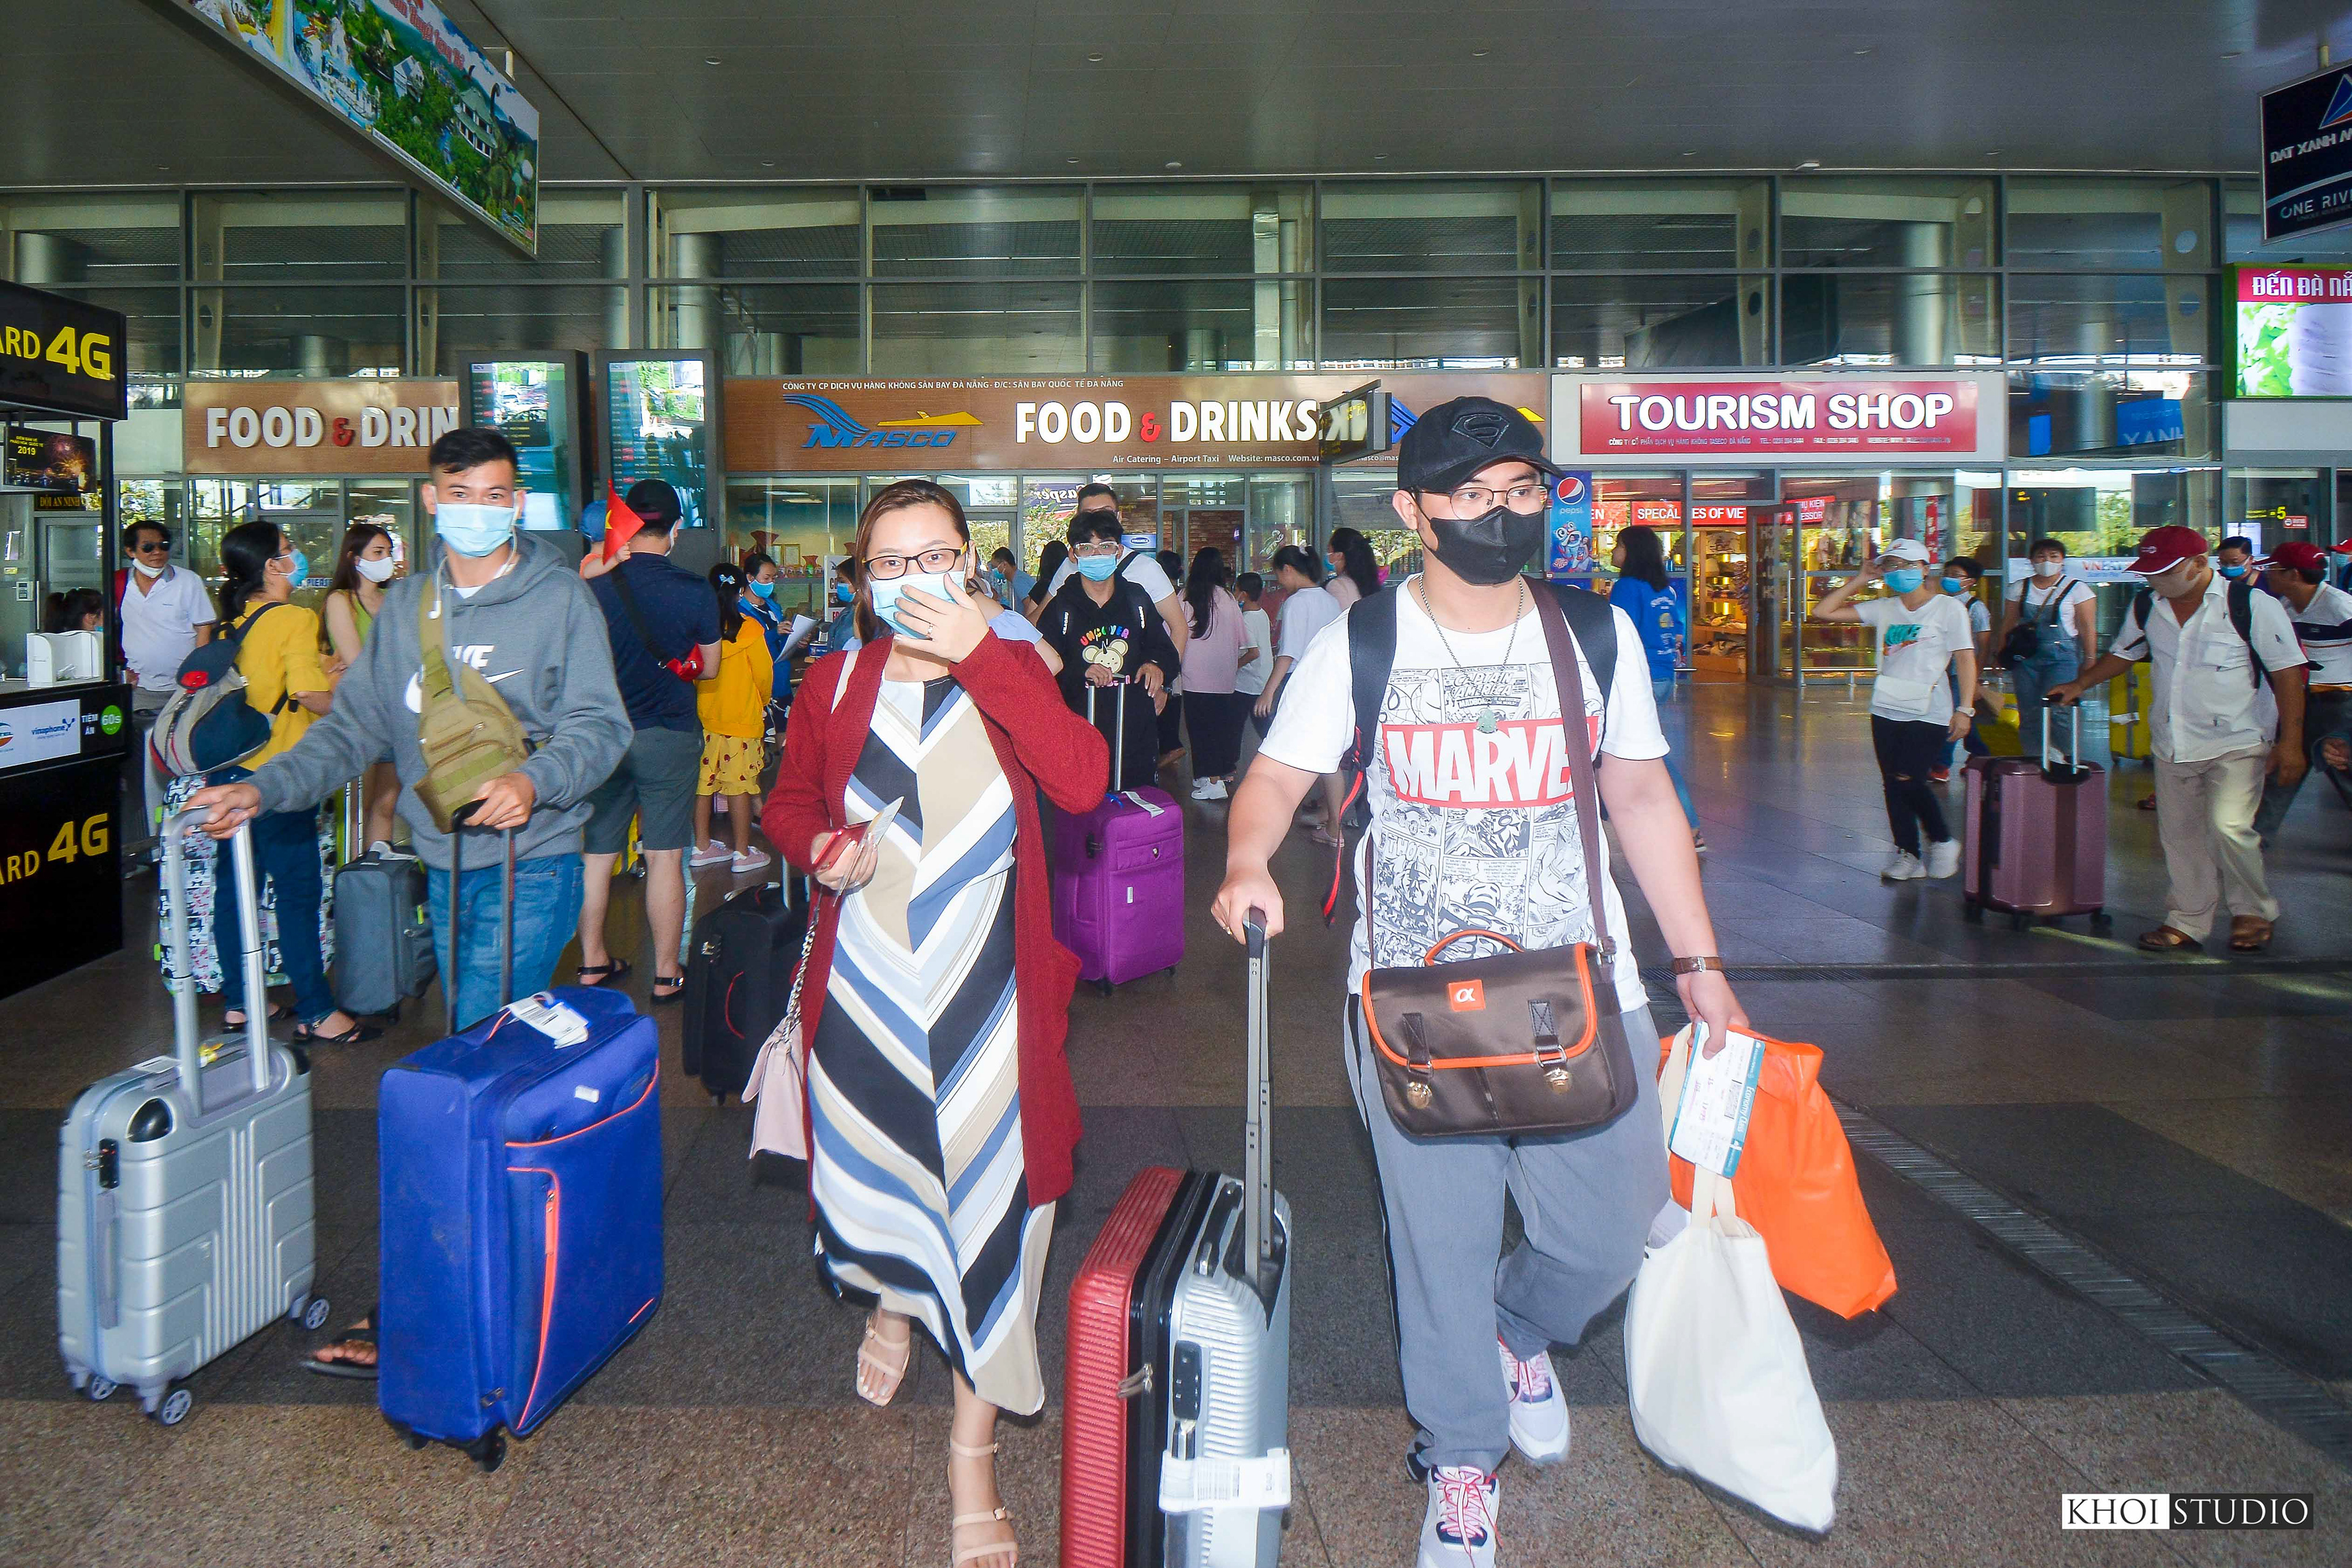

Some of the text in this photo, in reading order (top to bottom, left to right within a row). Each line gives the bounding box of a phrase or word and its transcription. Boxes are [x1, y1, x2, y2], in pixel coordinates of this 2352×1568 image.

[2297, 134, 2336, 155] XANH
[2280, 200, 2313, 219] ONE
[2323, 188, 2352, 208] RIV
[2252, 271, 2352, 296] ĐẾN ĐÀ NẴ
[46, 326, 111, 380] 4G
[783, 381, 805, 390] CÔNG
[831, 382, 849, 391] DỊCH
[851, 382, 862, 391] VỤ
[864, 380, 886, 389] HÀNG
[888, 380, 916, 390] KHÔNG
[952, 380, 964, 388] ĐÀ
[1048, 378, 1072, 388] QUỐC
[1075, 378, 1085, 388] TẾ
[1016, 401, 1132, 444] FOOD
[1140, 412, 1161, 442] &
[1170, 399, 1319, 442] DRINKS
[1609, 393, 1954, 431] TOURISM SHOP
[206, 406, 459, 448] FOOD & DRIN
[801, 424, 958, 448] MASCO
[17, 446, 36, 455] 2019
[1609, 436, 1623, 445] CÔNG
[1126, 455, 1161, 464] Catering
[1171, 455, 1200, 464] Airport
[1709, 508, 1724, 518] OF
[1727, 508, 1746, 518] VIE
[2277, 507, 2286, 519] 5
[31, 725, 65, 736] vinaphone
[102, 714, 121, 726] 60s
[1387, 725, 1573, 802] MARVE
[48, 813, 108, 864] 4G
[1741, 1086, 1755, 1118] Economy
